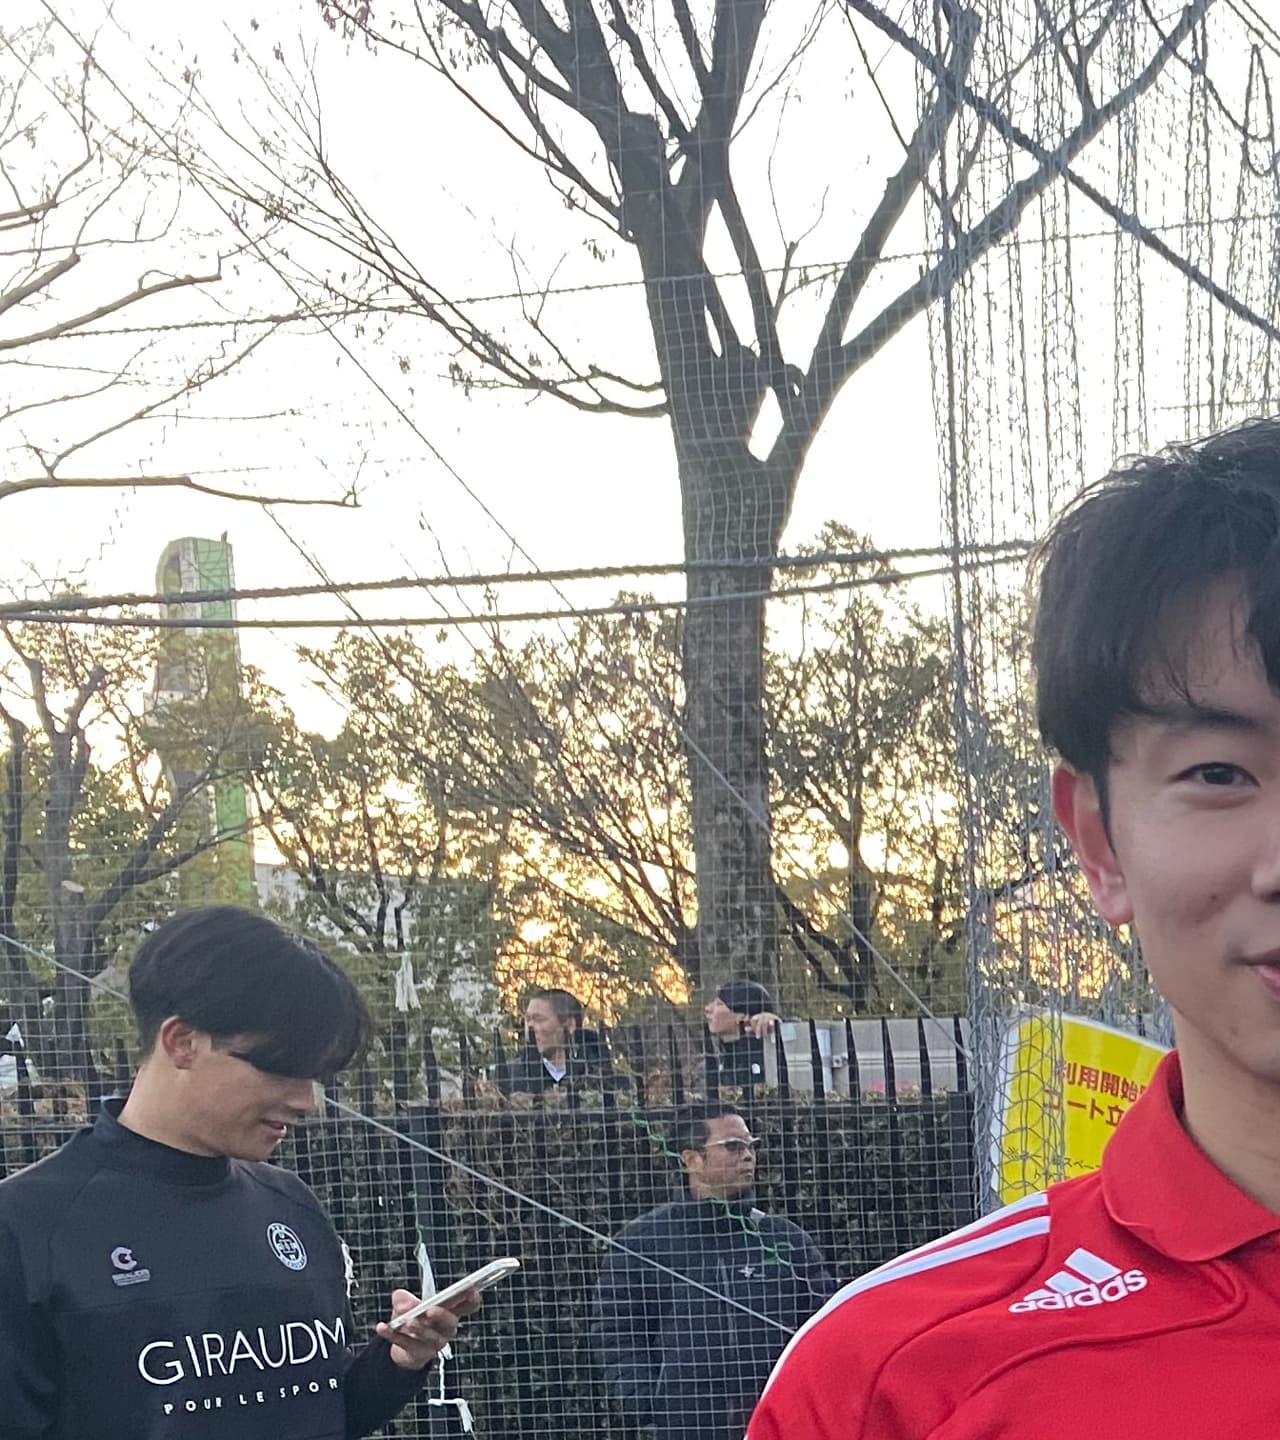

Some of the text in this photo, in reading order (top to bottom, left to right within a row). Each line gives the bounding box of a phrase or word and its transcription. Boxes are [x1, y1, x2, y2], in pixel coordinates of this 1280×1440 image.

[1008, 1268, 1148, 1313] adidas
[163, 1397, 223, 1415] POUR
[239, 1391, 264, 1406] LE
